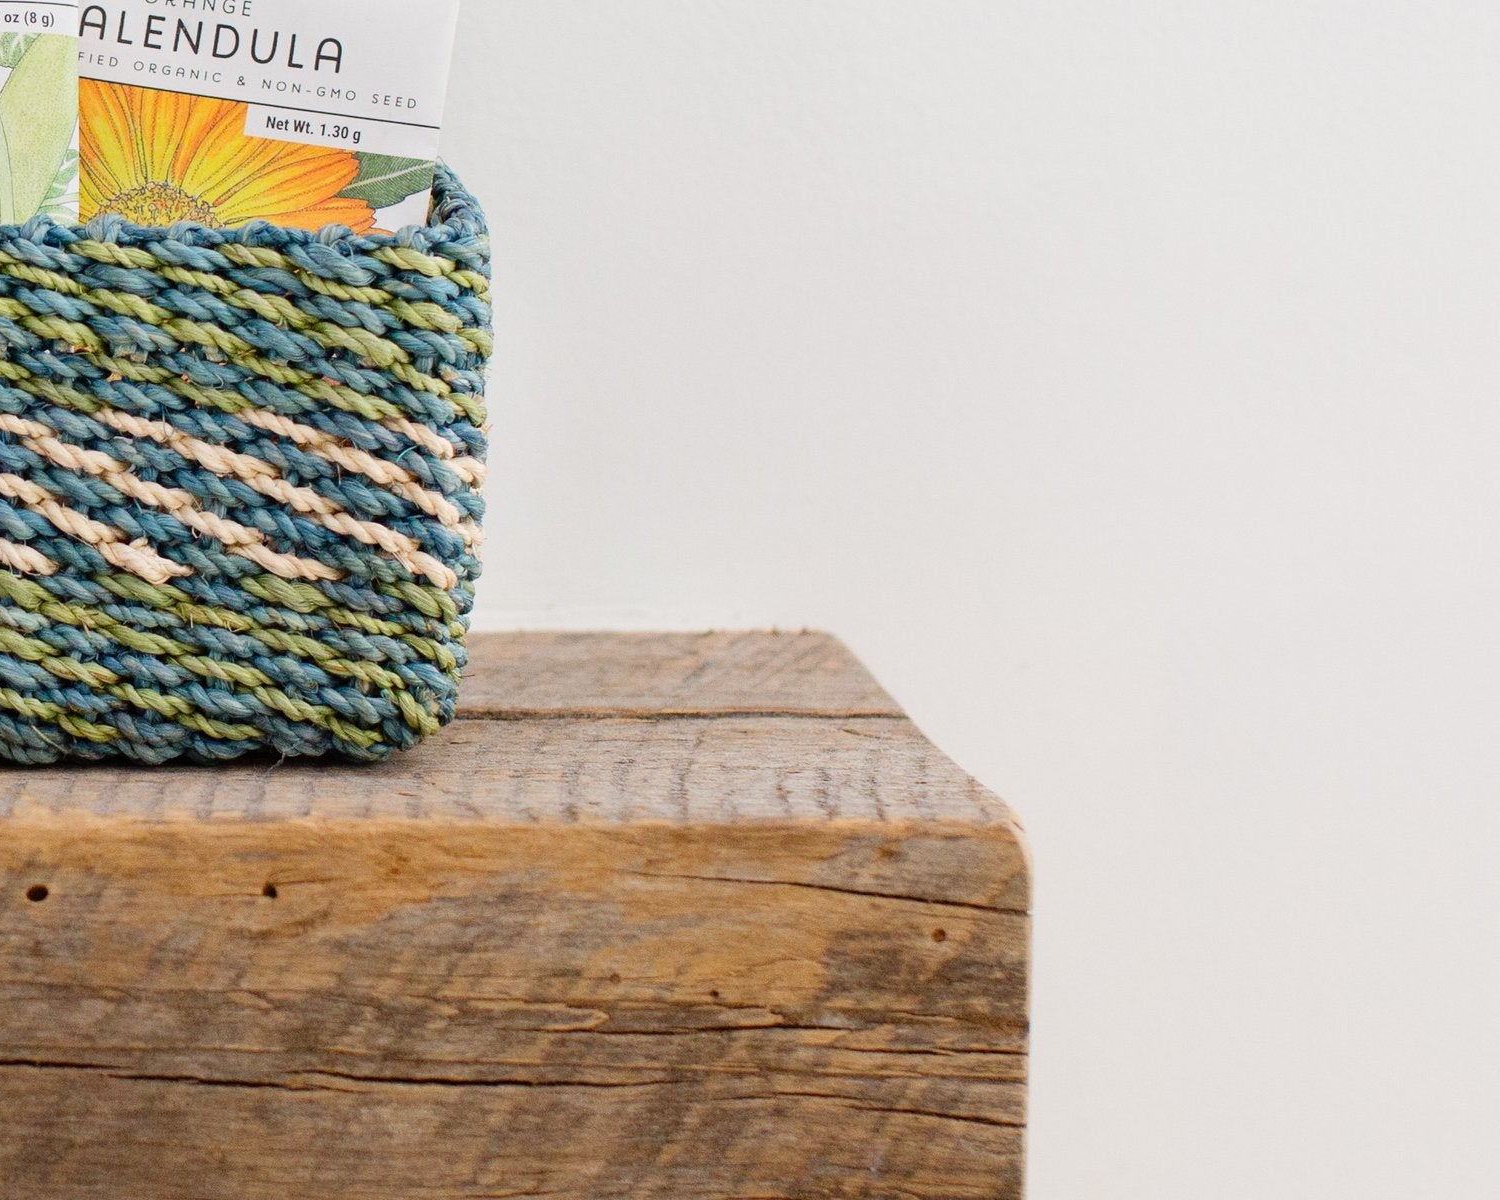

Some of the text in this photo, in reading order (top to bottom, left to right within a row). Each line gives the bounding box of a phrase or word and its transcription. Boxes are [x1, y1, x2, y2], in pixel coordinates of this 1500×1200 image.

[4, 13, 19, 24] oz
[24, 10, 38, 27] (8
[41, 11, 55, 28] g)
[78, 5, 343, 73] ALENDULA
[133, 61, 223, 83] ORGANIC
[236, 76, 246, 87] &
[261, 79, 357, 101] NON-GMO
[371, 93, 417, 109] SEED
[265, 115, 361, 144] Net Wt. 1.30 g
